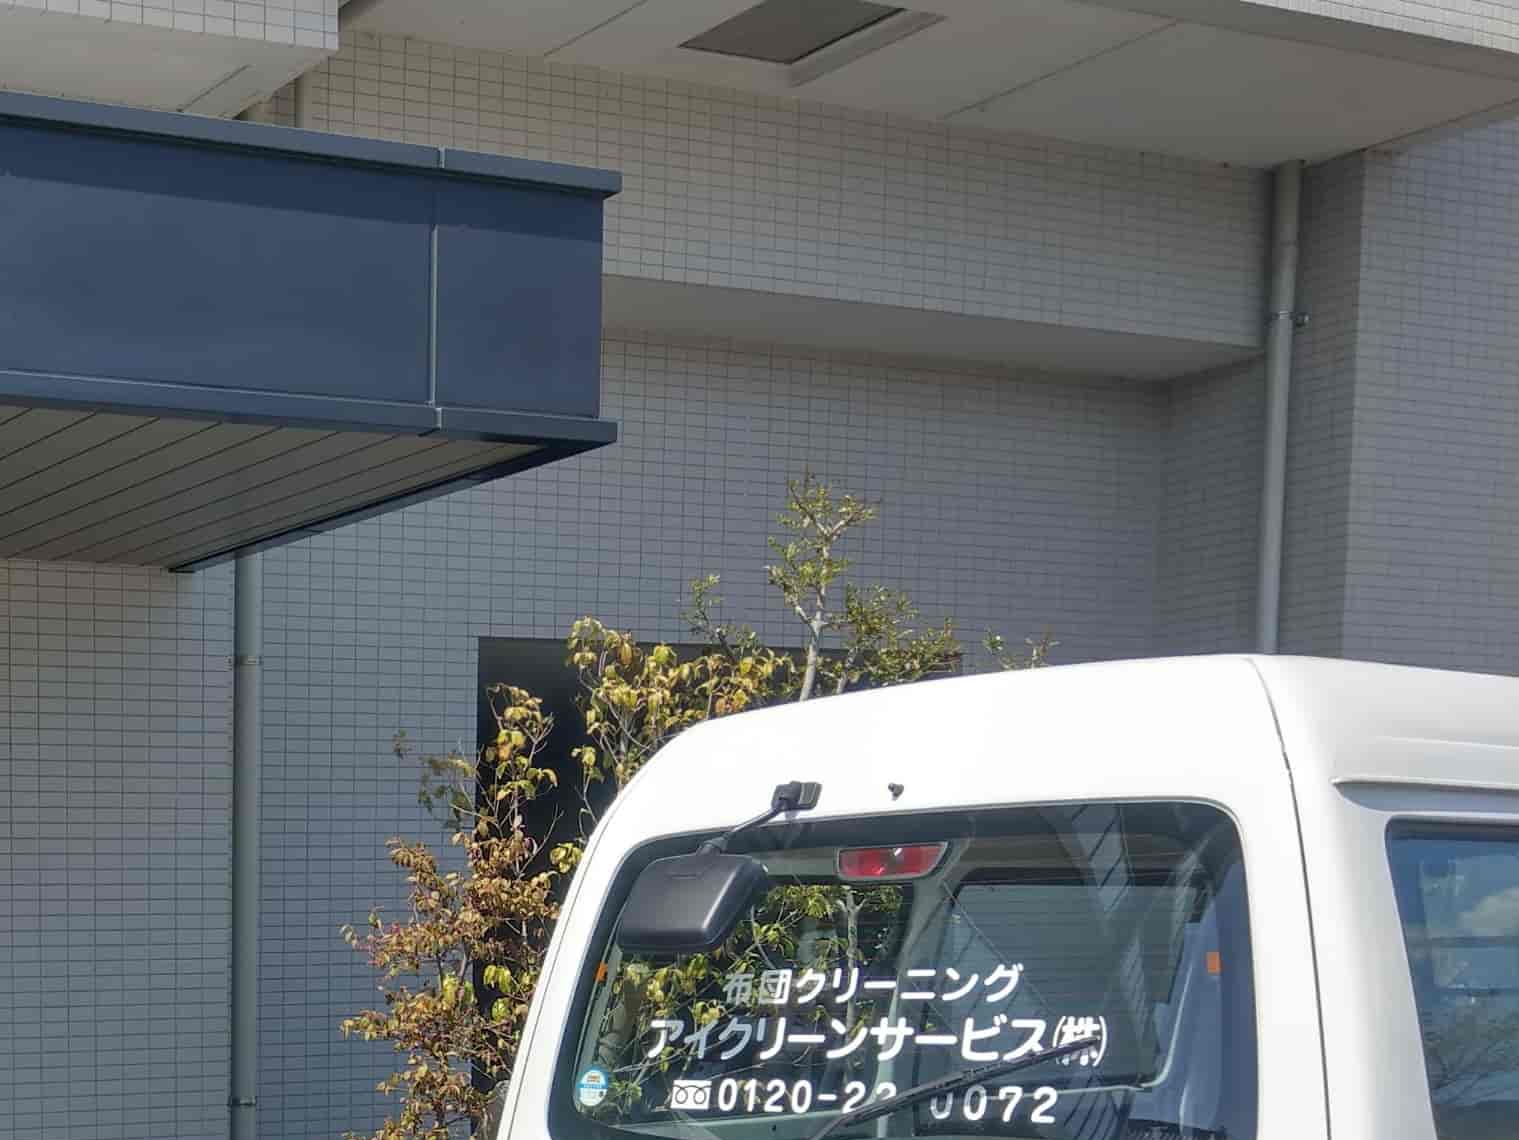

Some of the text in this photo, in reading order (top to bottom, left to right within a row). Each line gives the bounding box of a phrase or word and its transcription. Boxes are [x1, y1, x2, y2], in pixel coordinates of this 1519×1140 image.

[721, 962, 1025, 1005] 布団クリーニング
